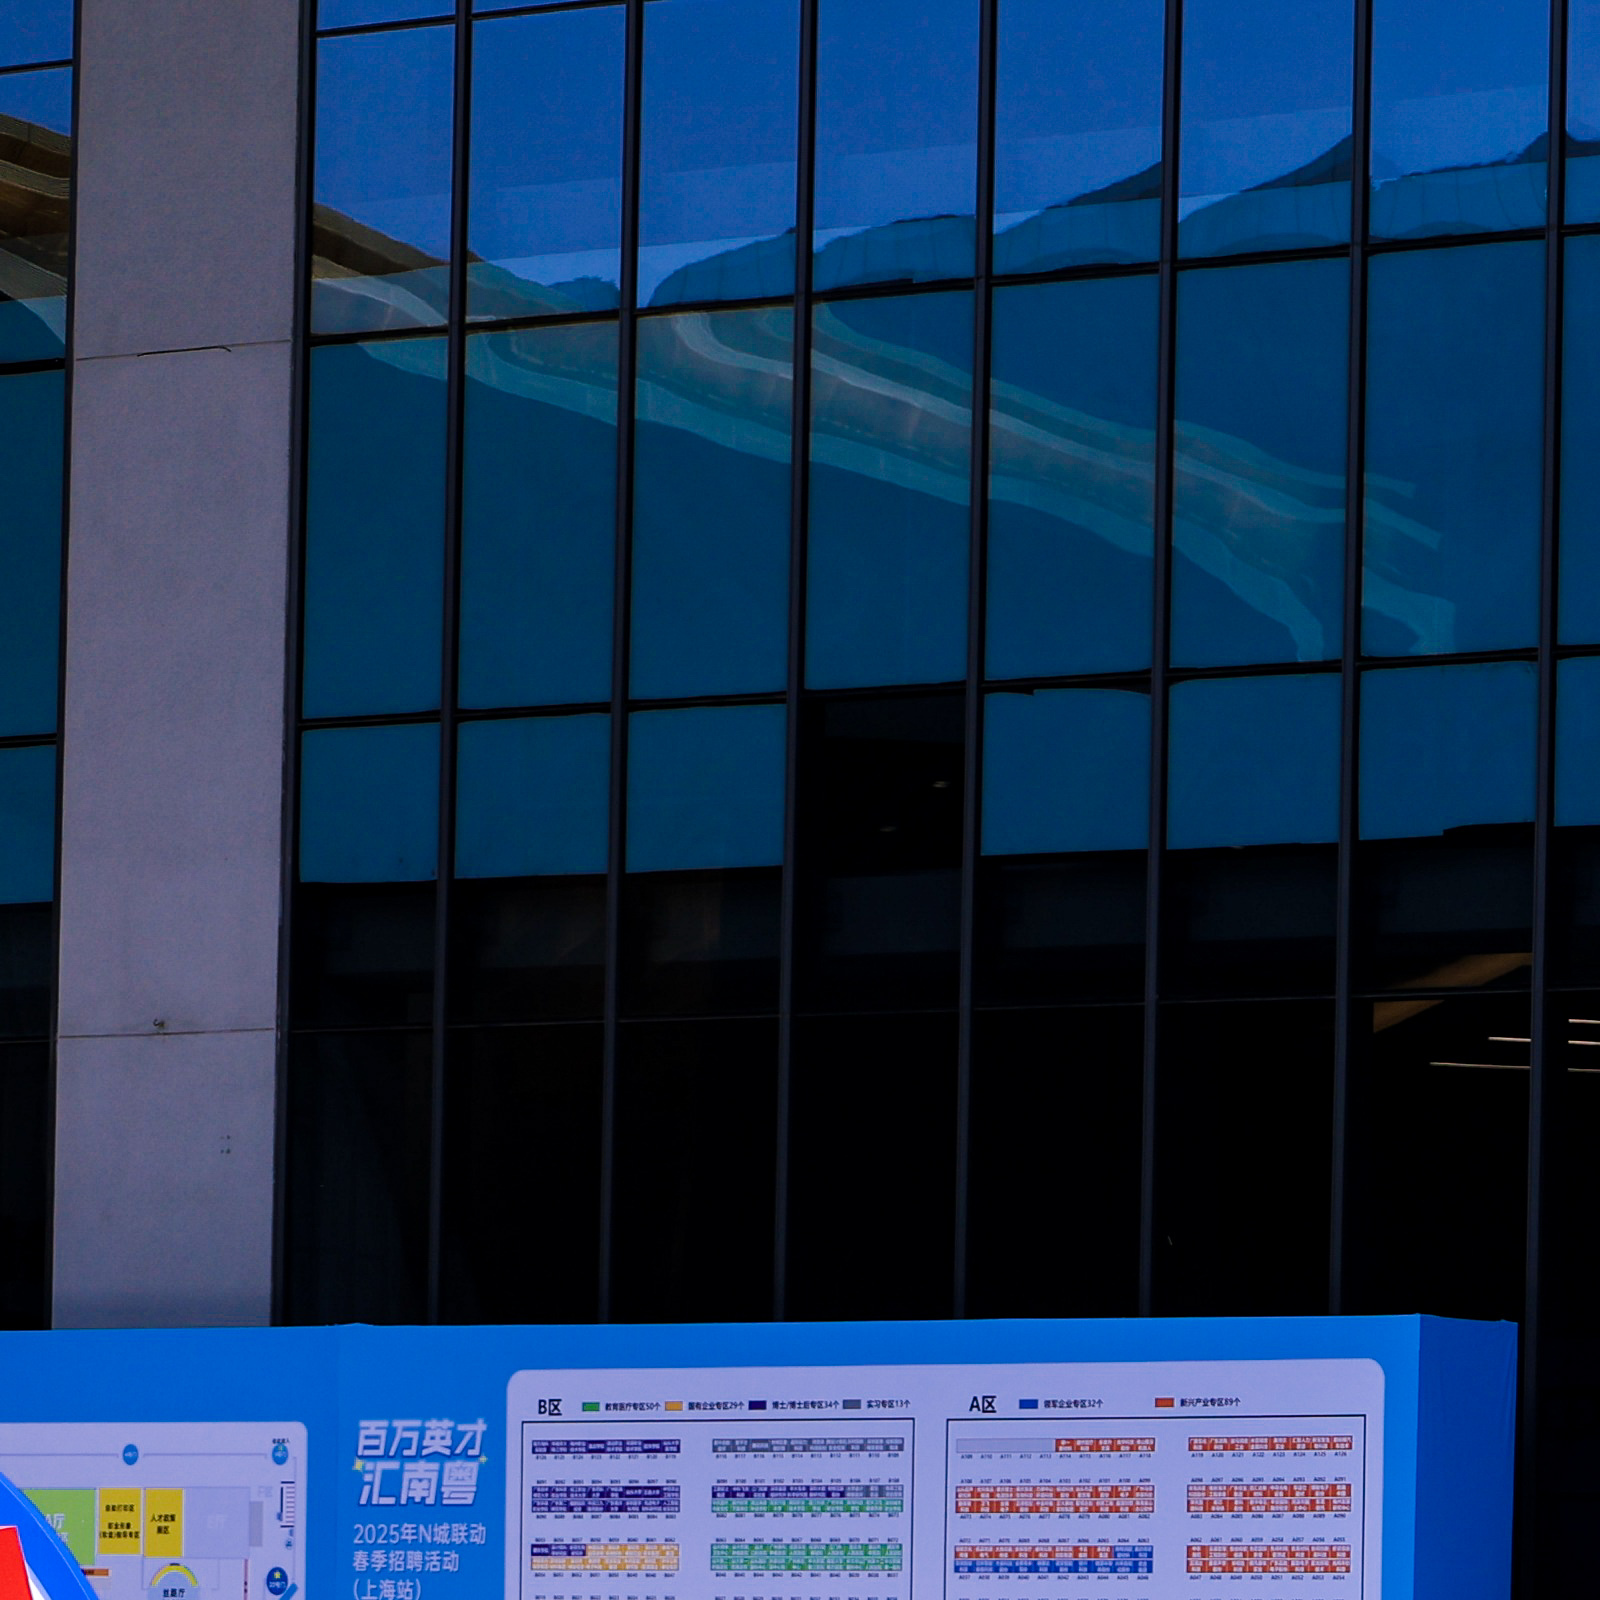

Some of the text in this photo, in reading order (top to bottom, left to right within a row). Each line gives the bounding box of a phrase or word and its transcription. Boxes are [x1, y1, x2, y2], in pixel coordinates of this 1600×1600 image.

[538, 1398, 562, 1416] B区
[969, 1395, 997, 1413] A区
[357, 1418, 488, 1457] 百万英才
[359, 1459, 480, 1505] 汇南粤
[353, 1522, 487, 1546] 2025年N城联动
[352, 1550, 460, 1573] 春季招聘活动
[353, 1578, 422, 1600] (上海站)
